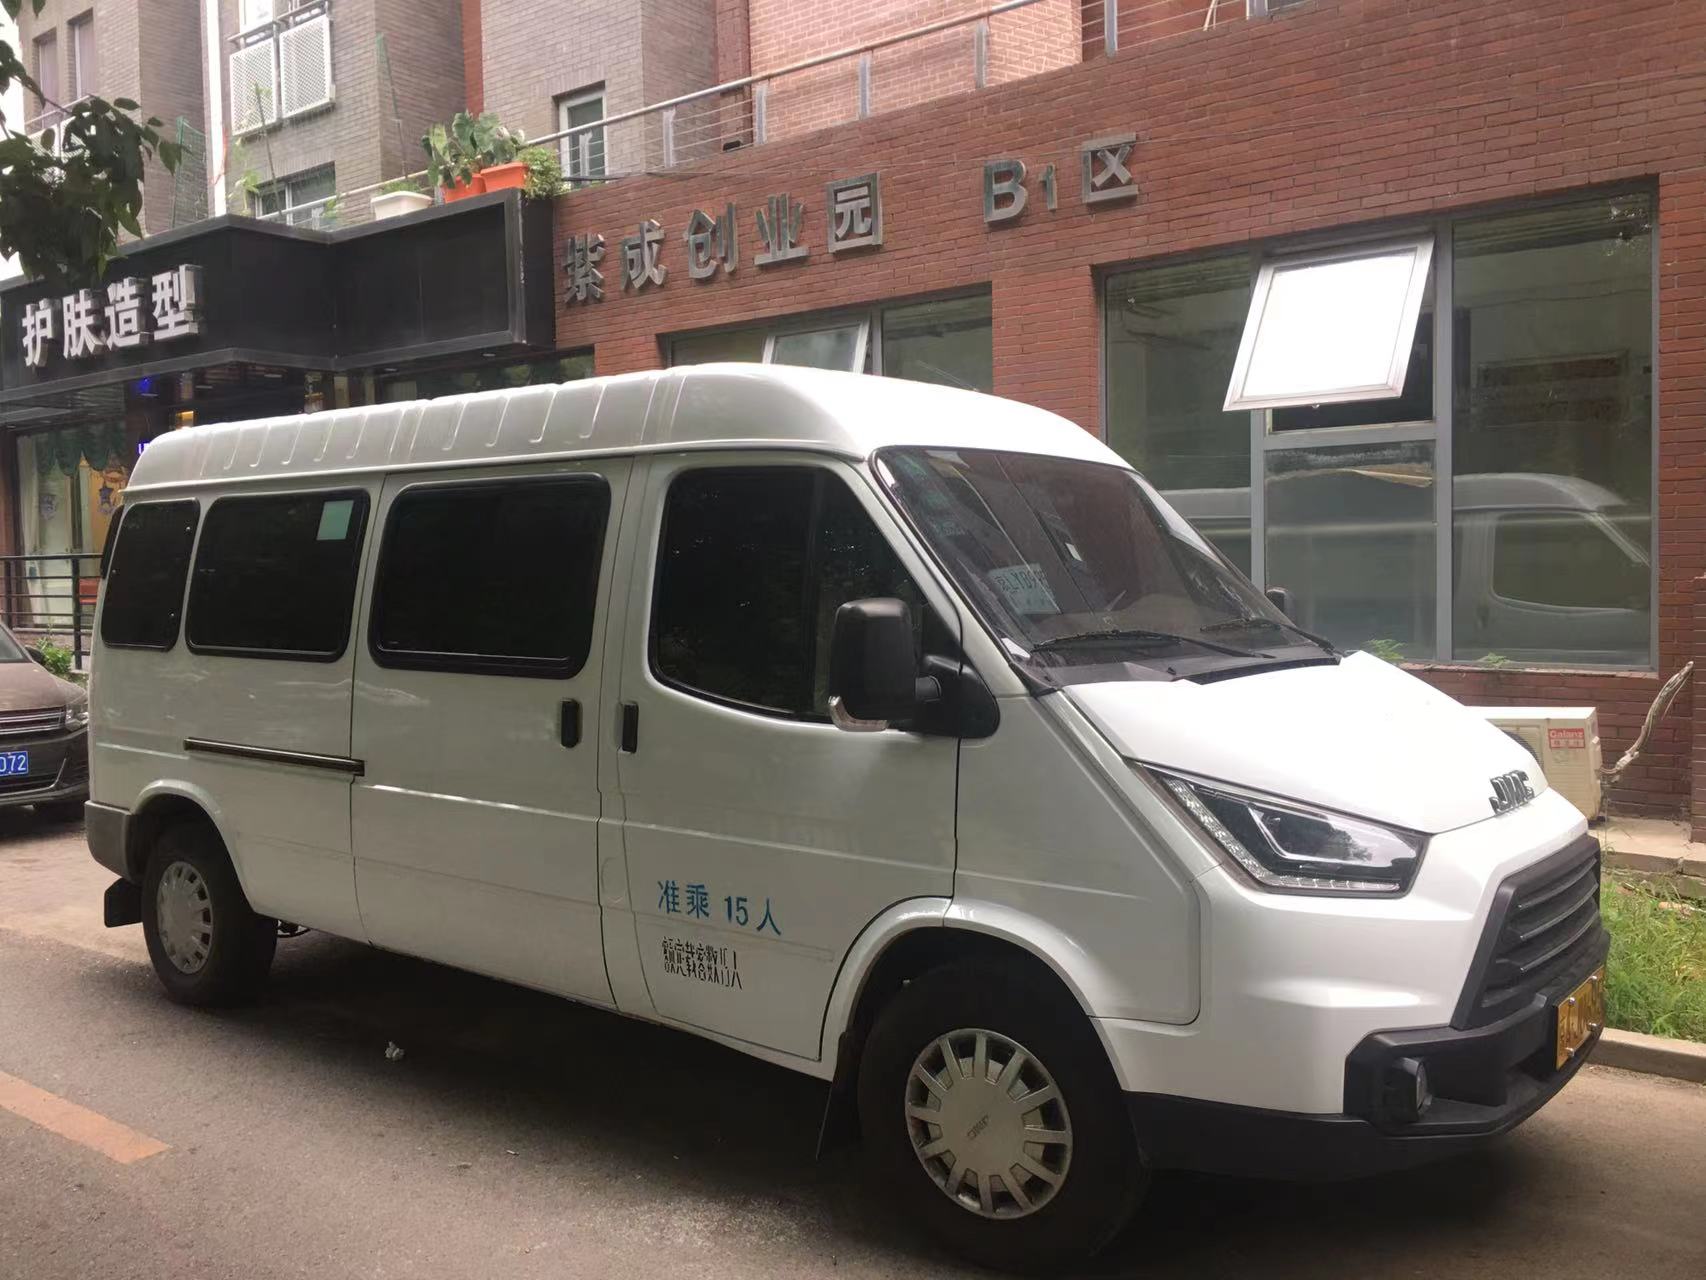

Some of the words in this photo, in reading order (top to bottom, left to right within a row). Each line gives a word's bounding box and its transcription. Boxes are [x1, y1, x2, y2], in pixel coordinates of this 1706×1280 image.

[564, 172, 883, 303] 紫成创业园
[22, 265, 202, 367] 护肤造型
